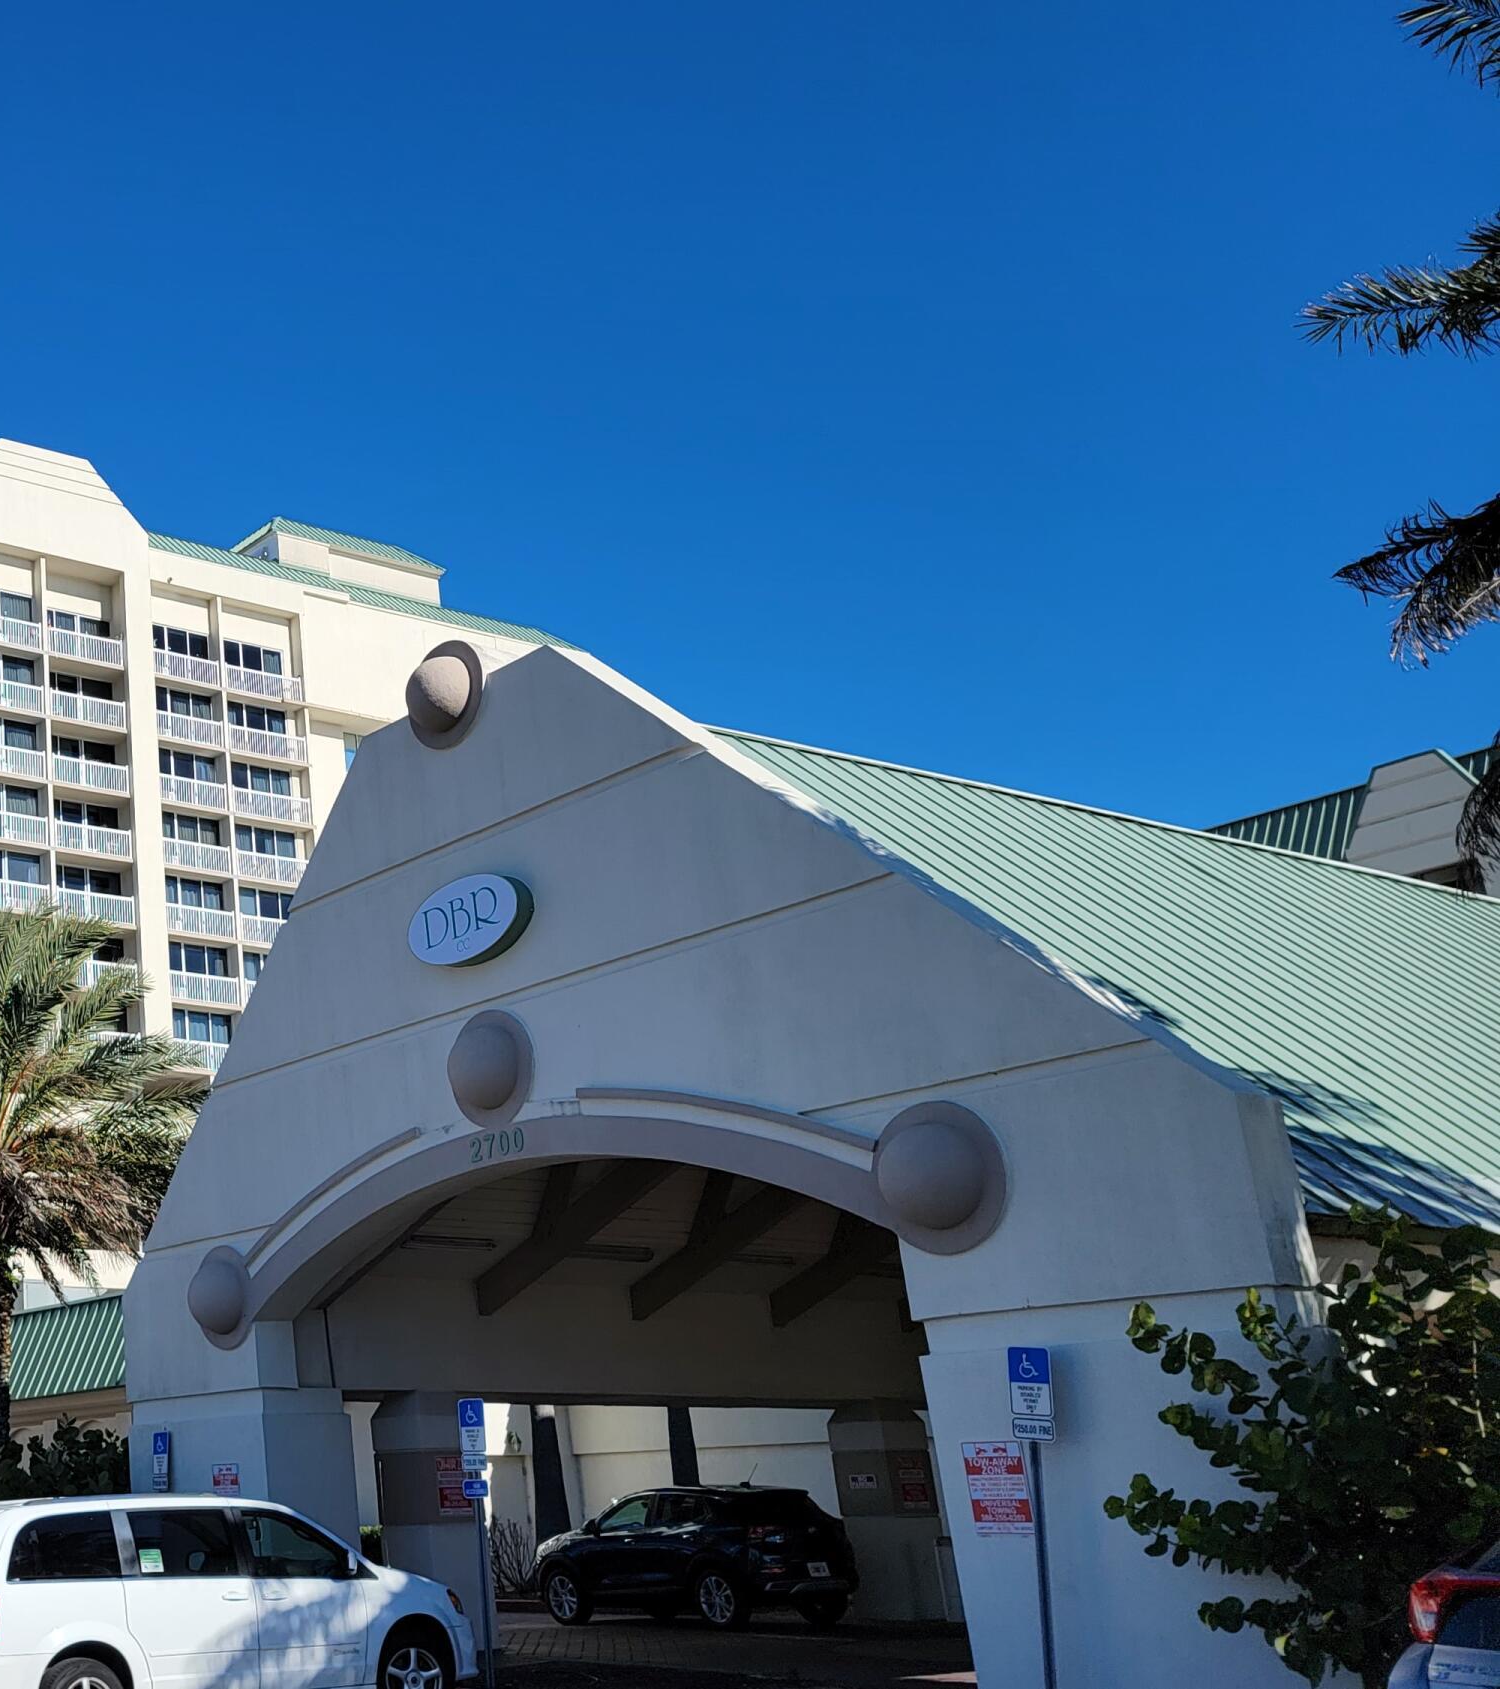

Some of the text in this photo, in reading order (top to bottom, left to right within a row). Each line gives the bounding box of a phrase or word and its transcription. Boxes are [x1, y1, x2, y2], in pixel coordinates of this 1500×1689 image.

[421, 886, 501, 951] DBR
[469, 1127, 524, 1164] 2700
[1038, 1425, 1052, 1436] FINE
[967, 1457, 1018, 1467] TOW-AWAY
[981, 1466, 1008, 1475] ZONE
[986, 1507, 1017, 1515] TOWING
